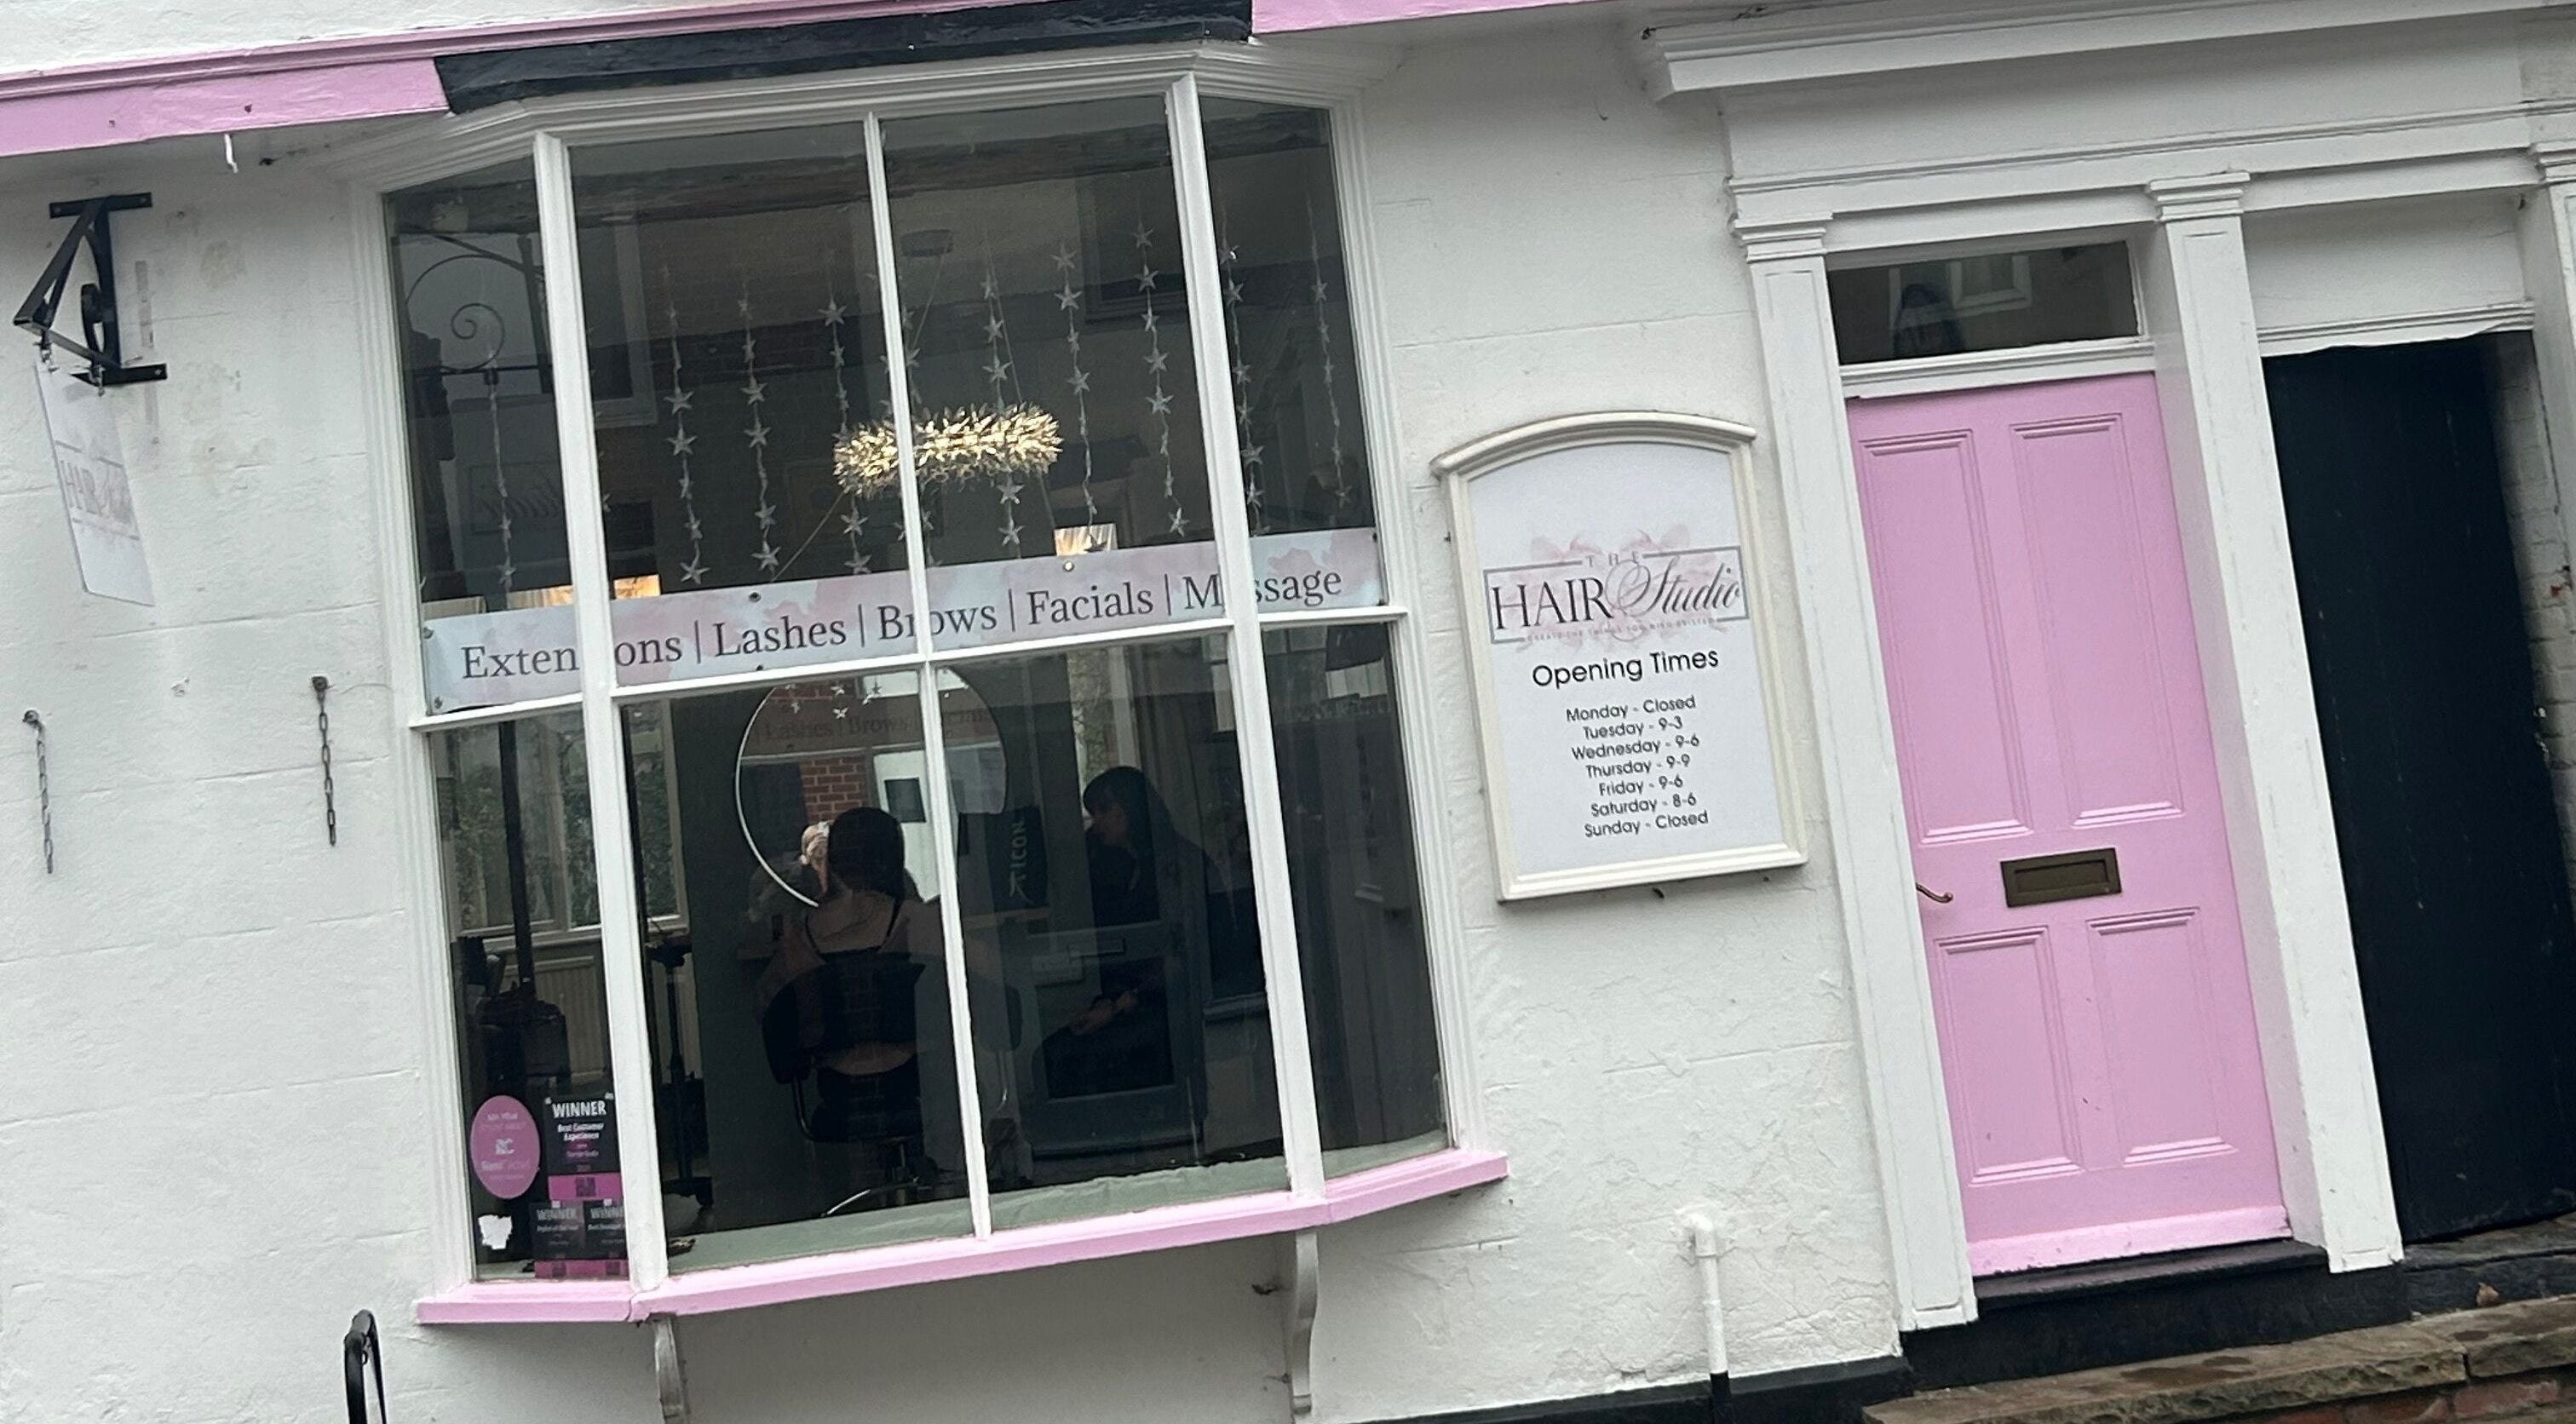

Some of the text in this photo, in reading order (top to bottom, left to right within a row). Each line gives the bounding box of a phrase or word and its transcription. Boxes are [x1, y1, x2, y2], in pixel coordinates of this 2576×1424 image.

[1492, 577, 1614, 629] HAIR
[1604, 554, 1740, 617] Studio
[461, 637, 682, 679] Extenons
[713, 615, 847, 657] Lashes
[1026, 581, 1154, 626] Facials
[1182, 570, 1343, 610] Msage
[1532, 651, 1719, 689] Opening Times
[1566, 704, 1629, 722] Monday
[1643, 694, 1696, 714] Closed
[1583, 722, 1644, 740] Tuesday
[1659, 715, 1683, 731] 9-3
[1571, 740, 1661, 761] Wednesday
[1675, 732, 1700, 749] 9-6
[1585, 760, 1652, 778] Thursday
[1666, 754, 1691, 769] 9-9
[1598, 780, 1644, 796] Friday
[1659, 773, 1683, 790] 9-6
[1590, 798, 1658, 818] Saturday
[1672, 791, 1697, 807] 8-6
[1584, 820, 1641, 838] Sunday
[1655, 809, 1709, 830] Closed
[551, 1100, 607, 1119] WINNER
